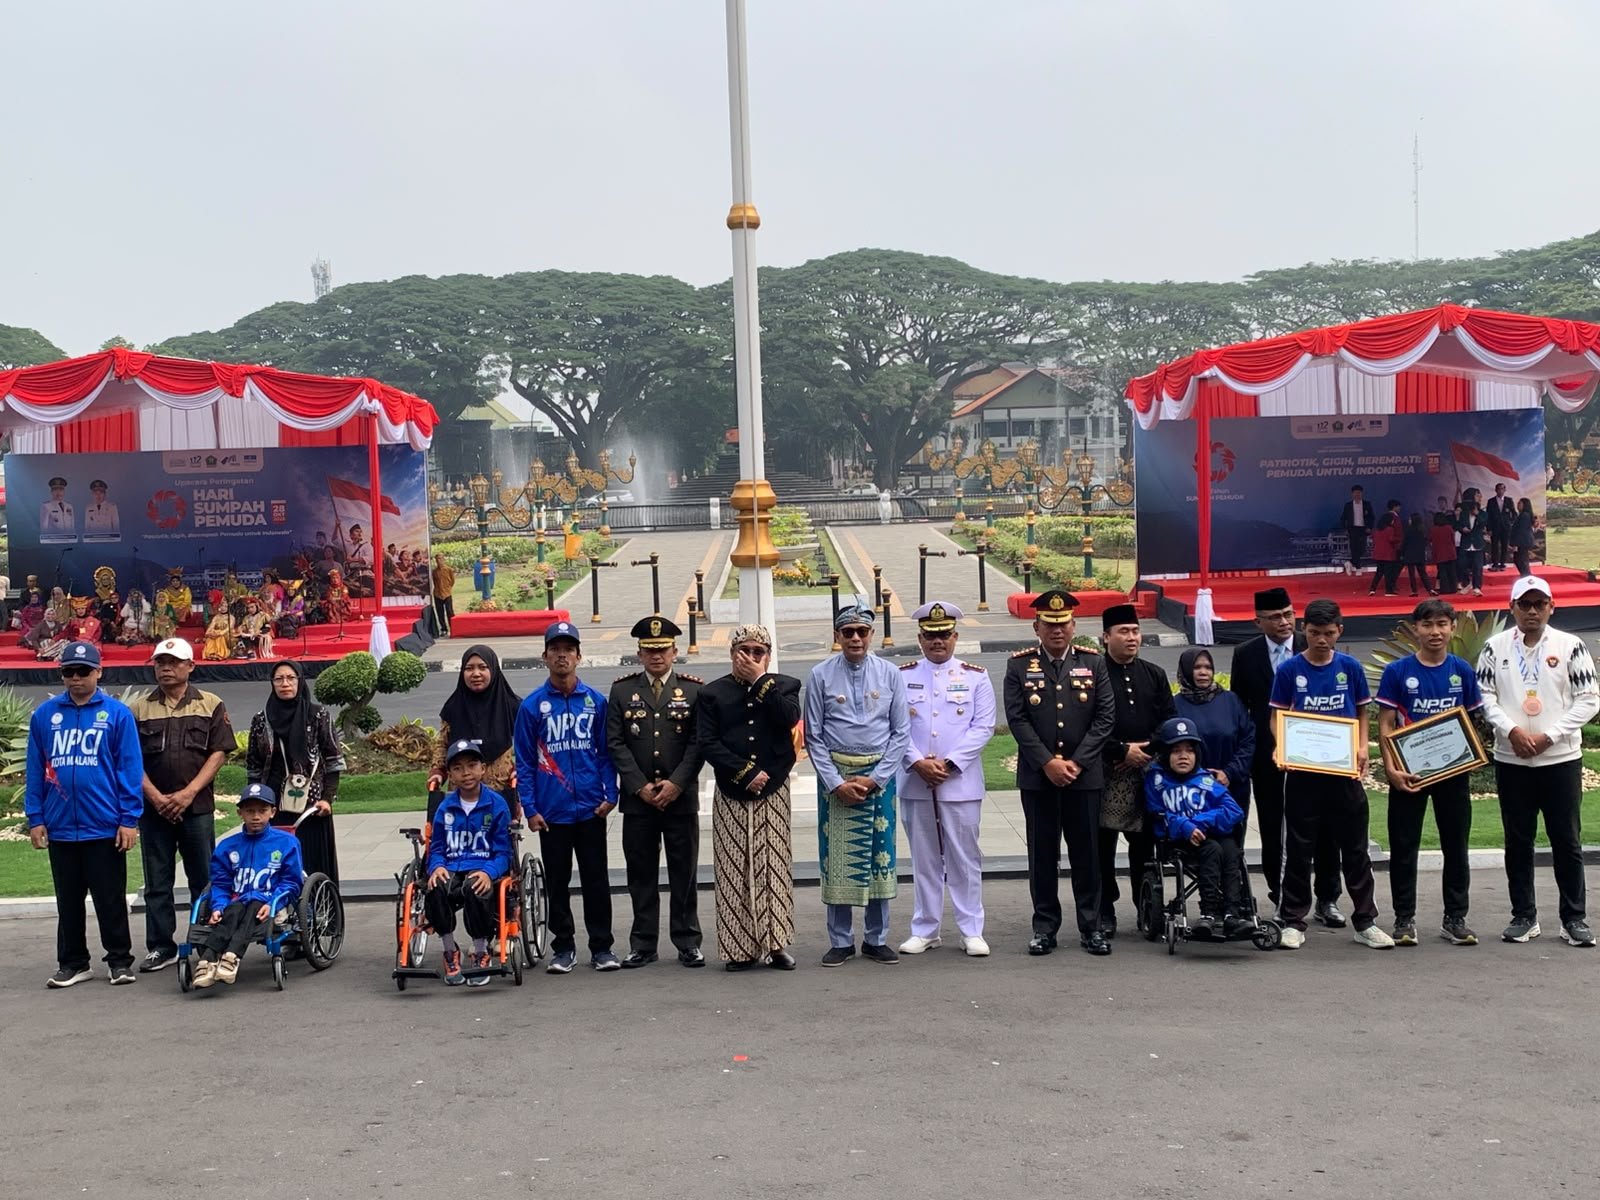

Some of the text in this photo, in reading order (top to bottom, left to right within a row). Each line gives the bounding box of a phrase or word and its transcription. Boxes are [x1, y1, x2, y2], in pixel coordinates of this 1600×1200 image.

[1260, 458, 1319, 468] PATRIOTIK,
[1322, 457, 1354, 466] GIGIH,
[1266, 465, 1415, 478] PEMUDA UNTUK INDONESIA
[193, 488, 234, 500] HARI
[193, 500, 265, 514] SUMPAH
[272, 504, 285, 512] 28
[194, 514, 267, 528] PEMUDA
[1304, 693, 1345, 706] NPCI
[1413, 697, 1457, 709] NPCI
[546, 712, 594, 742] NPCI
[51, 728, 103, 757] NPCI
[547, 739, 591, 753] KOTA MALANG
[66, 755, 98, 766] MALANG
[1162, 785, 1206, 812] NPCI
